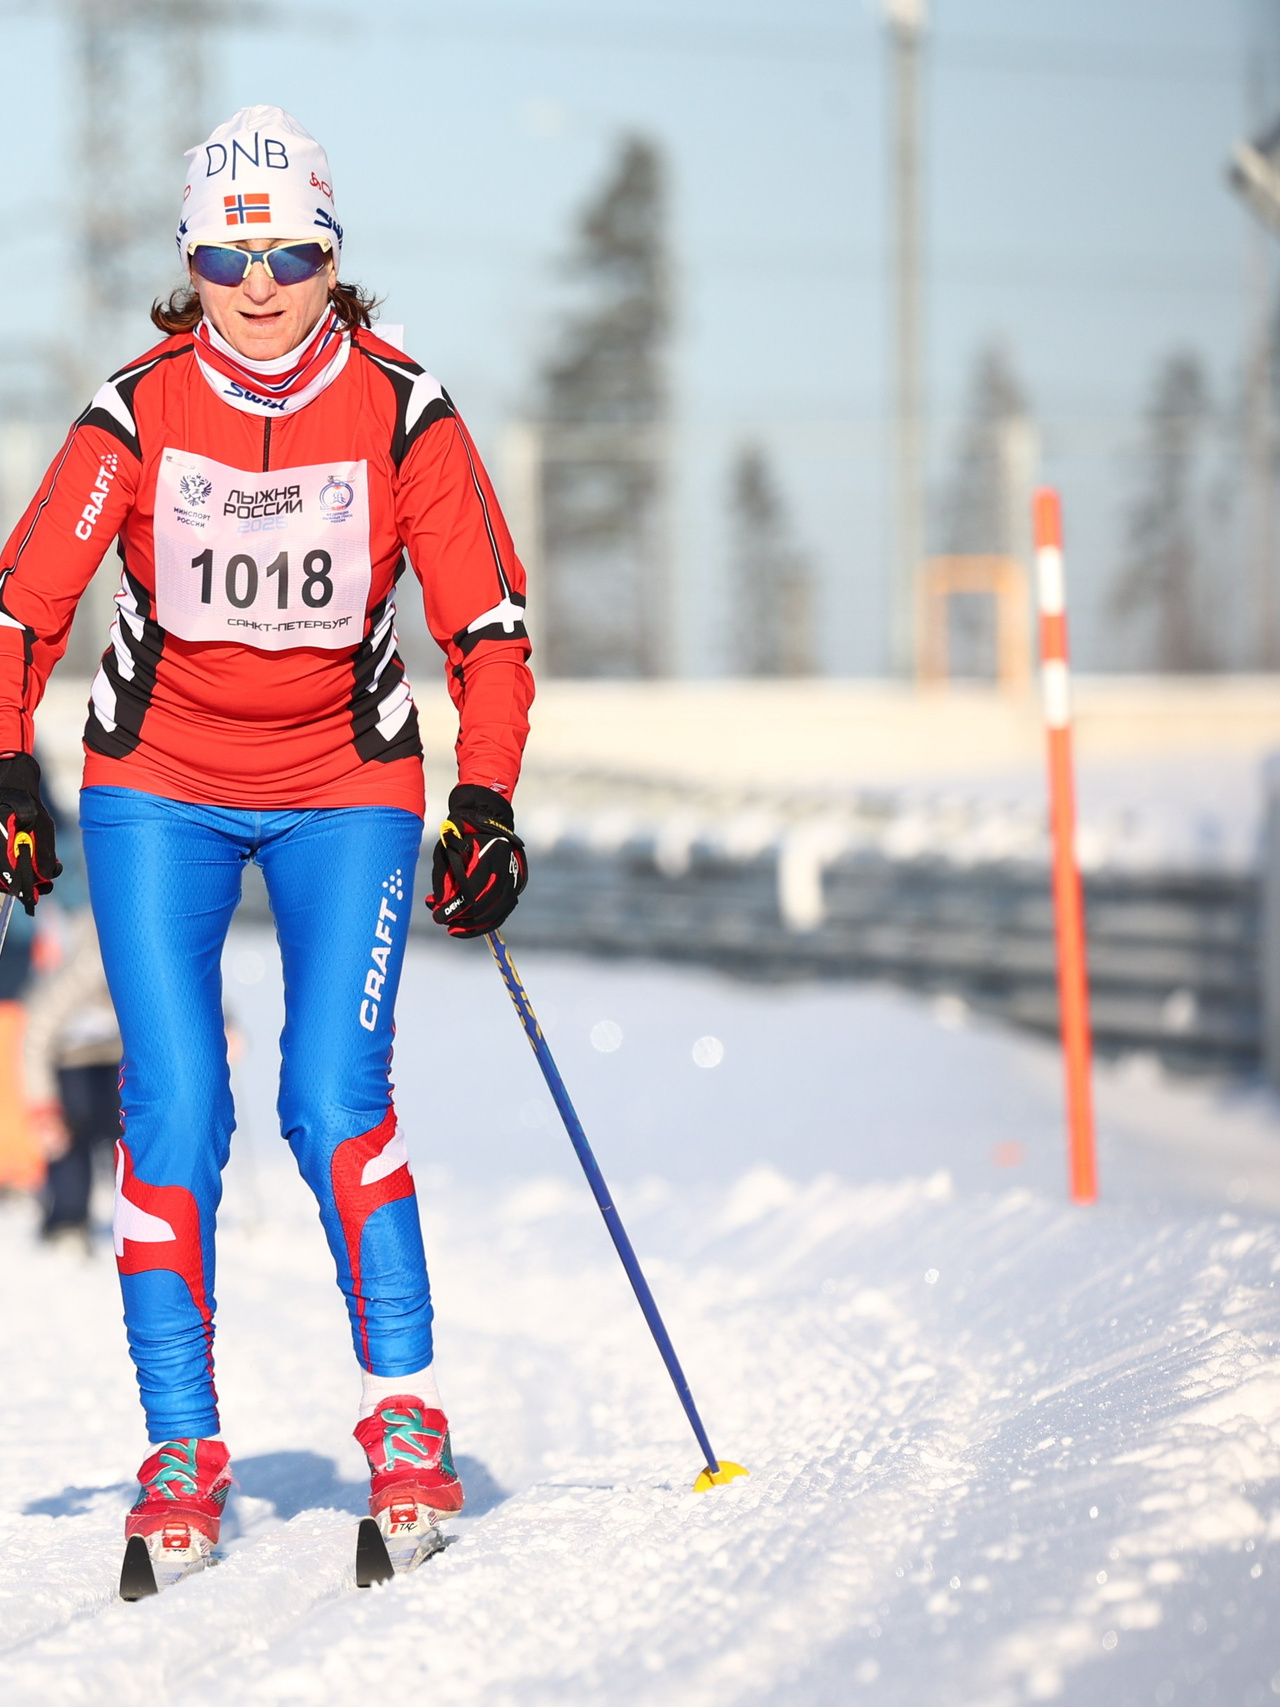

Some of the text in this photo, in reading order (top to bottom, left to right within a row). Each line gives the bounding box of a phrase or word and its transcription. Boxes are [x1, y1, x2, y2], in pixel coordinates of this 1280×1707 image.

[206, 131, 289, 180] DNB
[75, 465, 115, 540] CRAFT
[227, 484, 300, 504] ЛЫЖНЯ
[173, 507, 211, 521] МИНСПОРТ
[223, 499, 303, 519] РОССИИ
[177, 516, 205, 528] РОССИИ
[237, 515, 289, 533] 2025
[191, 548, 334, 609] 1018
[227, 616, 353, 632] САНКТ-ПЕТЕРБУРГ
[359, 897, 398, 1032] CRAFT
